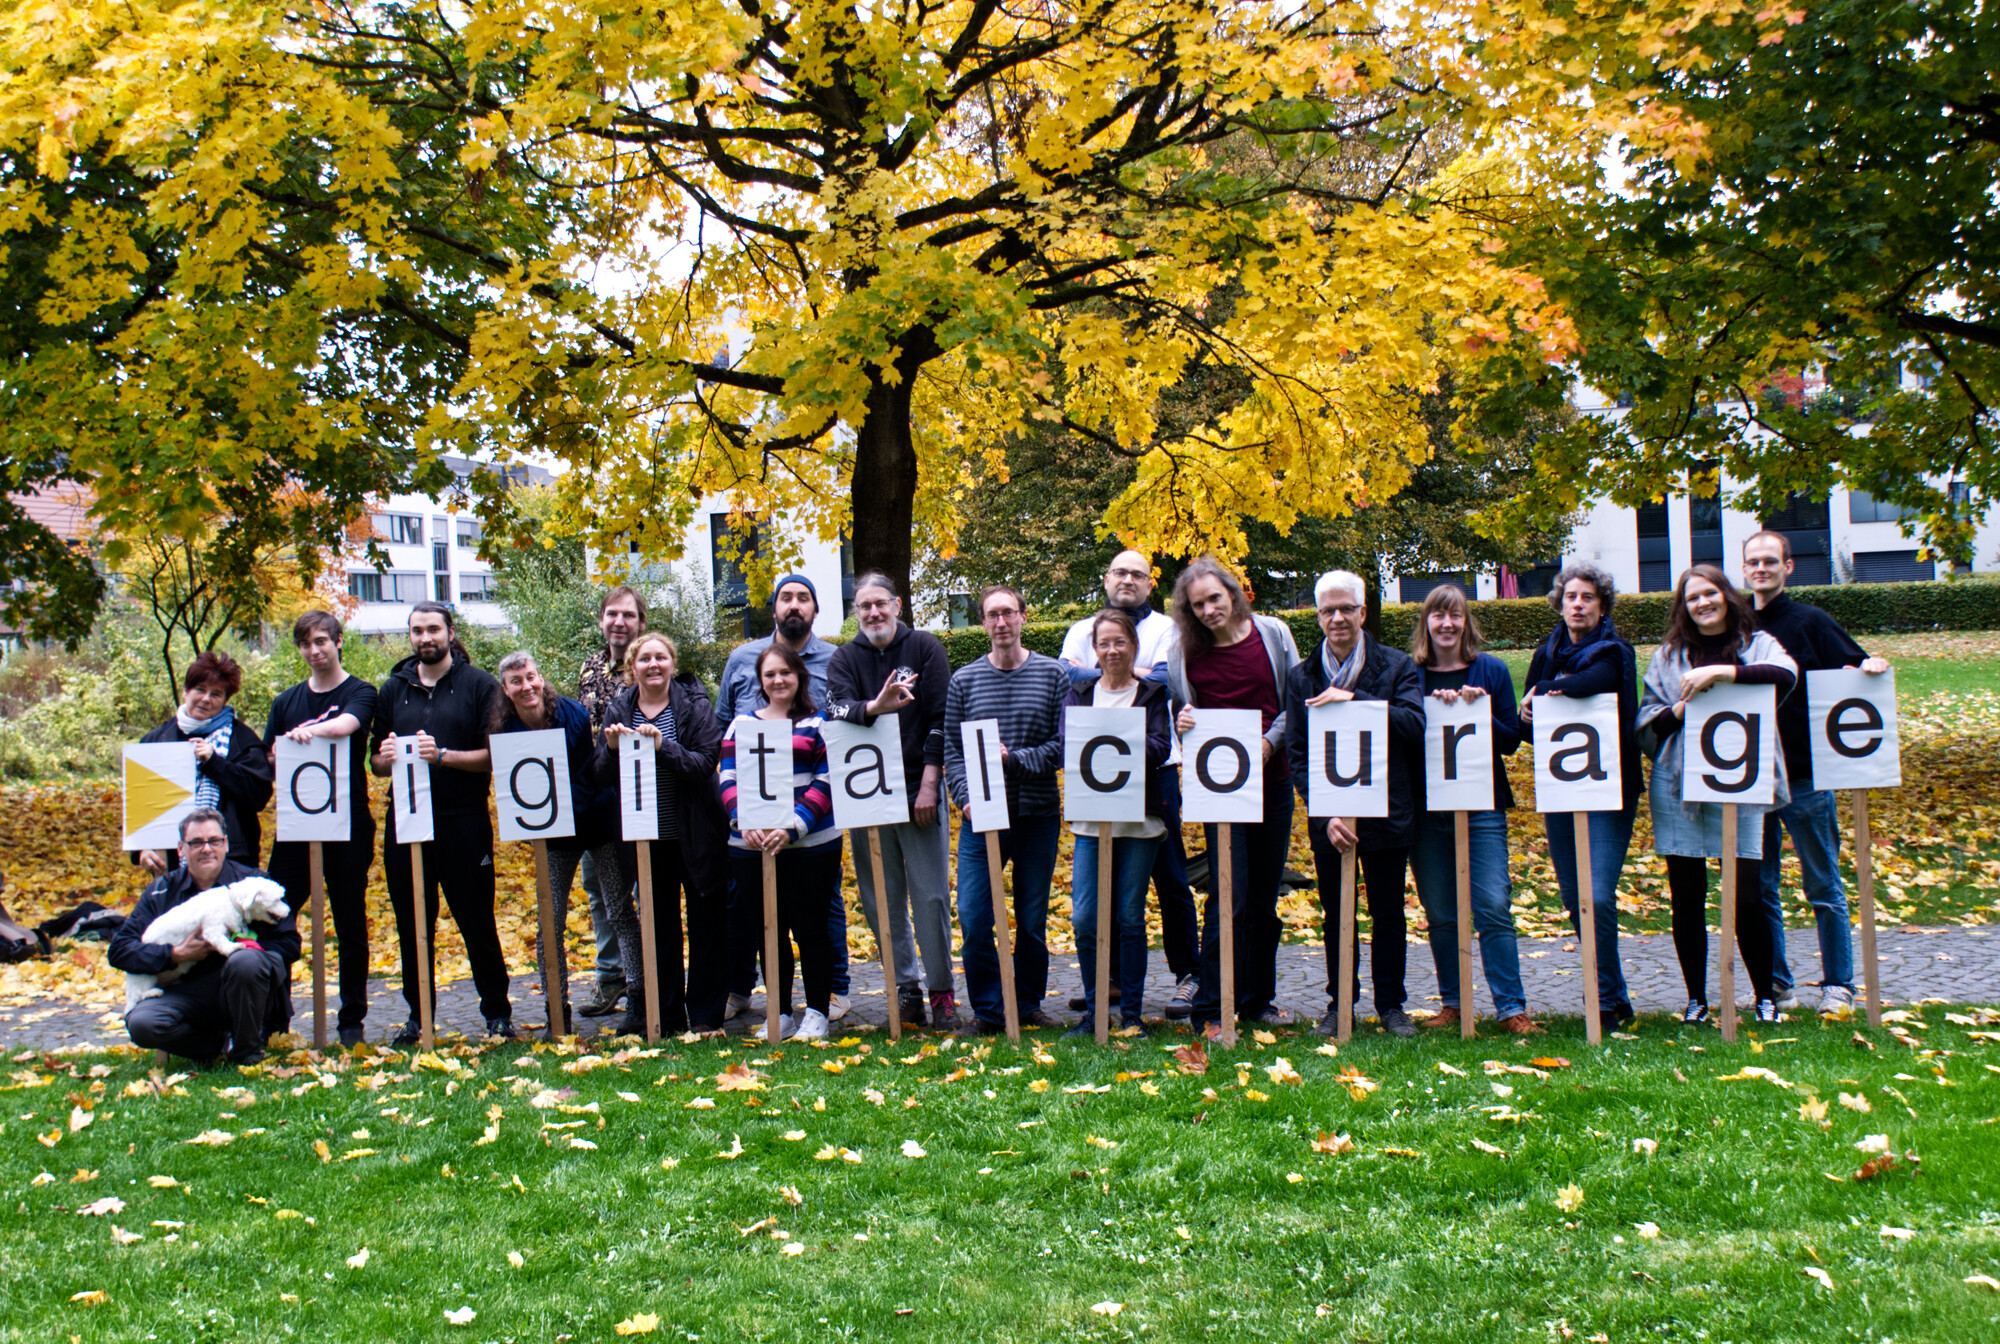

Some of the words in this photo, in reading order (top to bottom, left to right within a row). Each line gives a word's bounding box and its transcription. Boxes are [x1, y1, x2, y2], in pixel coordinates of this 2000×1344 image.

[1443, 723, 1476, 780] r
[1549, 722, 1607, 782] a
[1701, 710, 1760, 793] g
[1826, 697, 1883, 758] e
[291, 743, 337, 815] d
[406, 744, 417, 814] i
[633, 739, 642, 811] i
[749, 732, 777, 801] t
[844, 743, 893, 800] a
[1079, 734, 1131, 793] c
[1196, 736, 1250, 793] o
[1325, 730, 1371, 787] u
[509, 757, 559, 831] g
